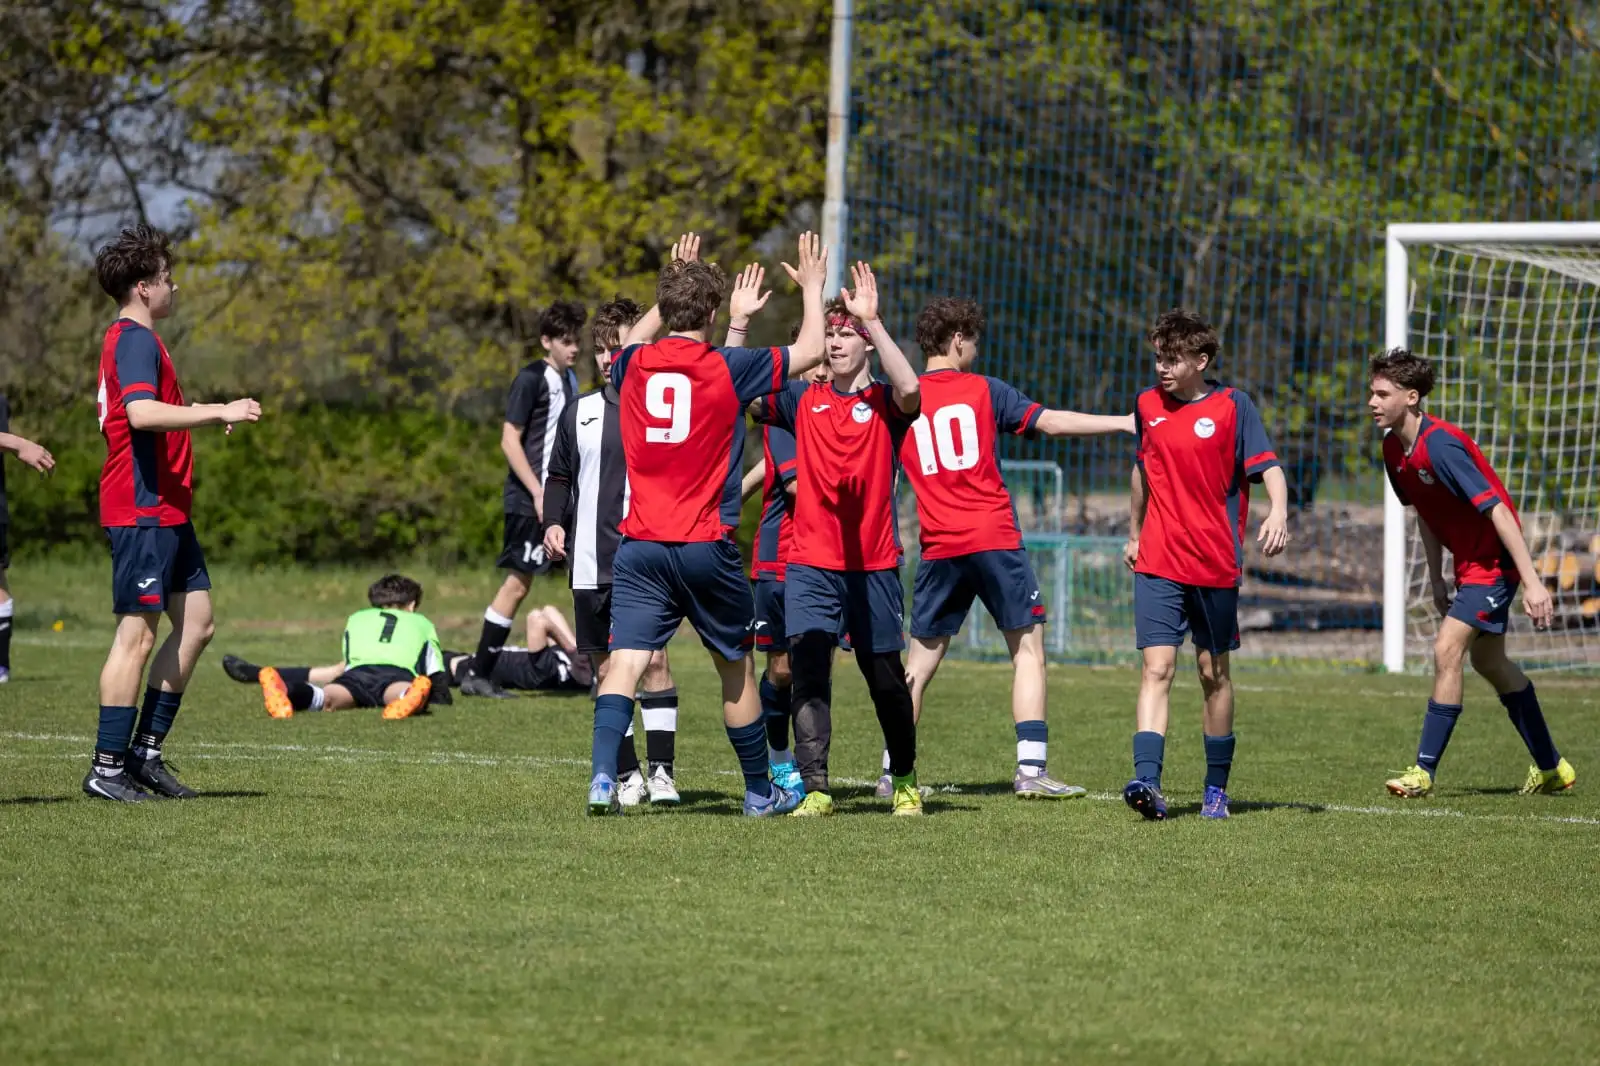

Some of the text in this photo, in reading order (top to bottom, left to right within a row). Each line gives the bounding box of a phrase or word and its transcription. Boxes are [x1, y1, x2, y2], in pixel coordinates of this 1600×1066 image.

[646, 372, 692, 444] 9
[911, 403, 979, 476] 10
[523, 541, 544, 565] 14
